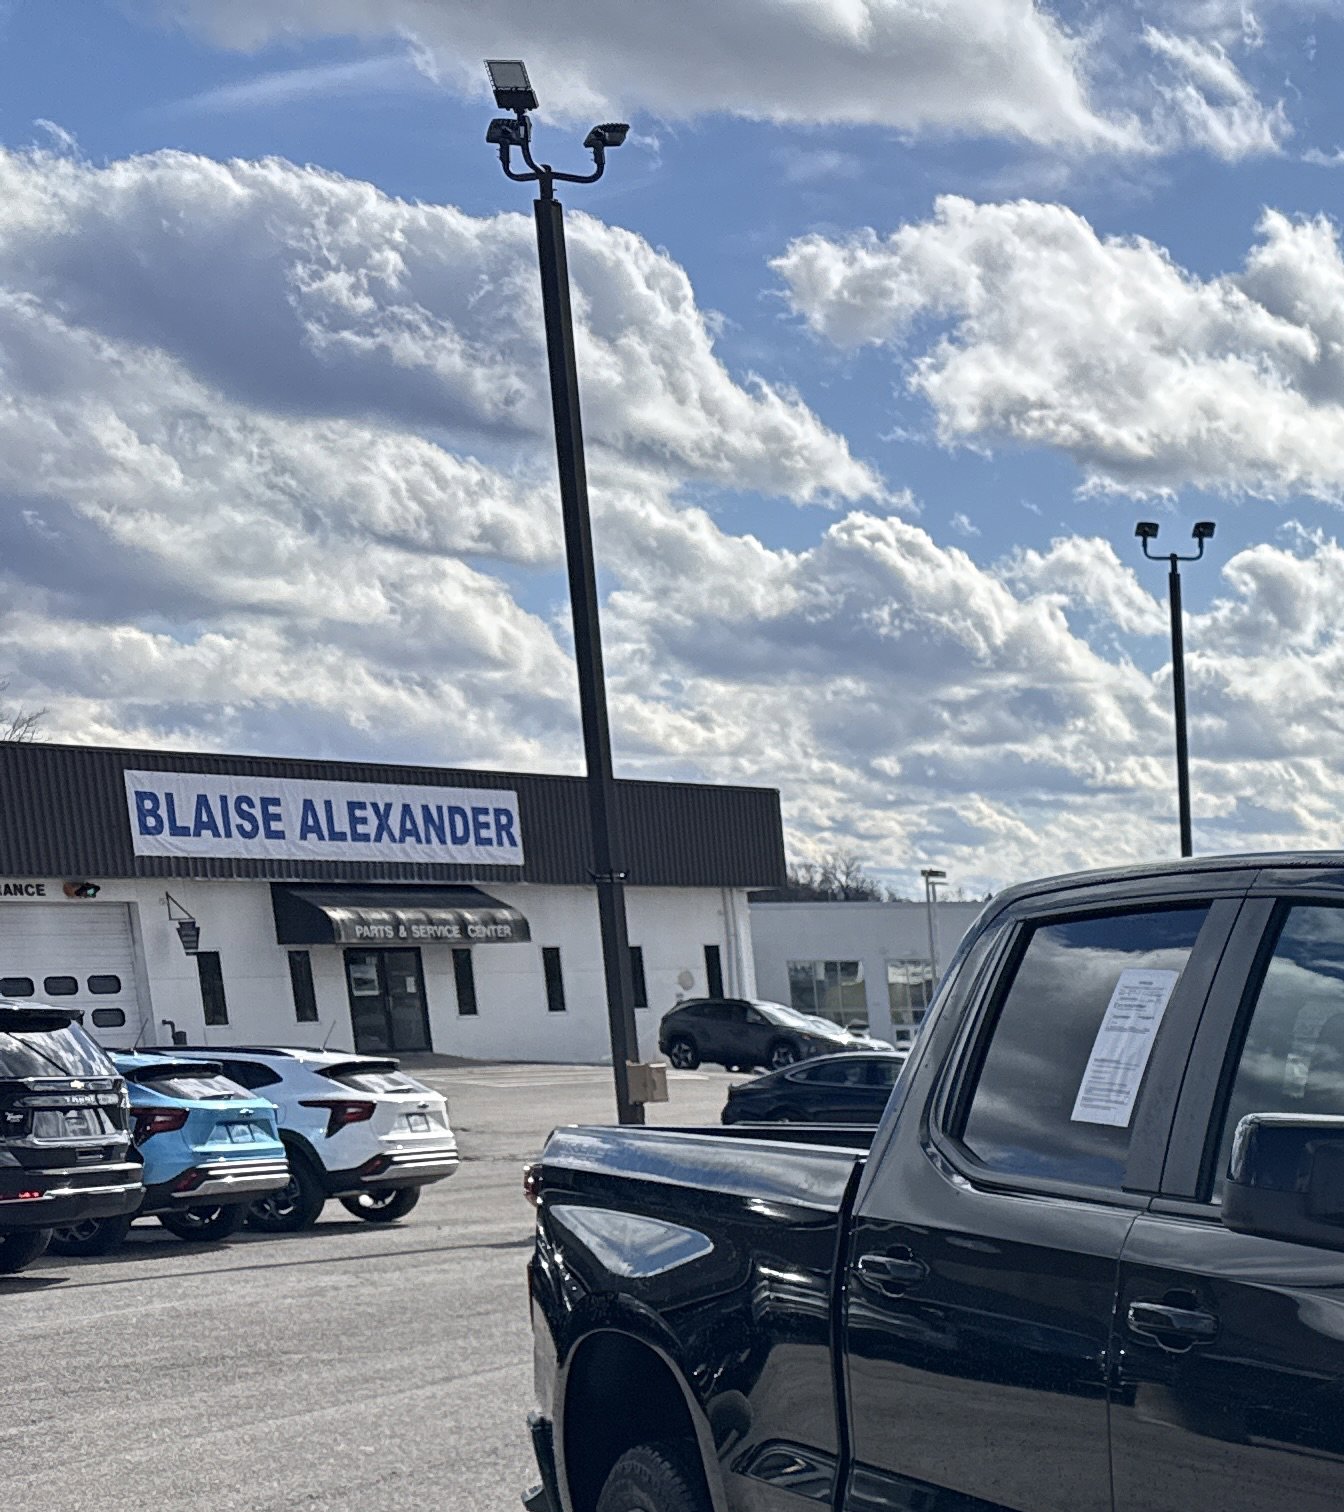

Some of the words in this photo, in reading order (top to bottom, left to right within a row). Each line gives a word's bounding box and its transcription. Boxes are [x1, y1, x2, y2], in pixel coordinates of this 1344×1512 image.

[133, 789, 286, 841] BLAISE
[299, 798, 519, 848] ALEXANDER
[0, 883, 46, 897] ANCE
[355, 925, 394, 938] PARTS
[399, 926, 407, 938] &
[411, 925, 461, 938] SERVICE
[467, 924, 512, 938] CENTER
